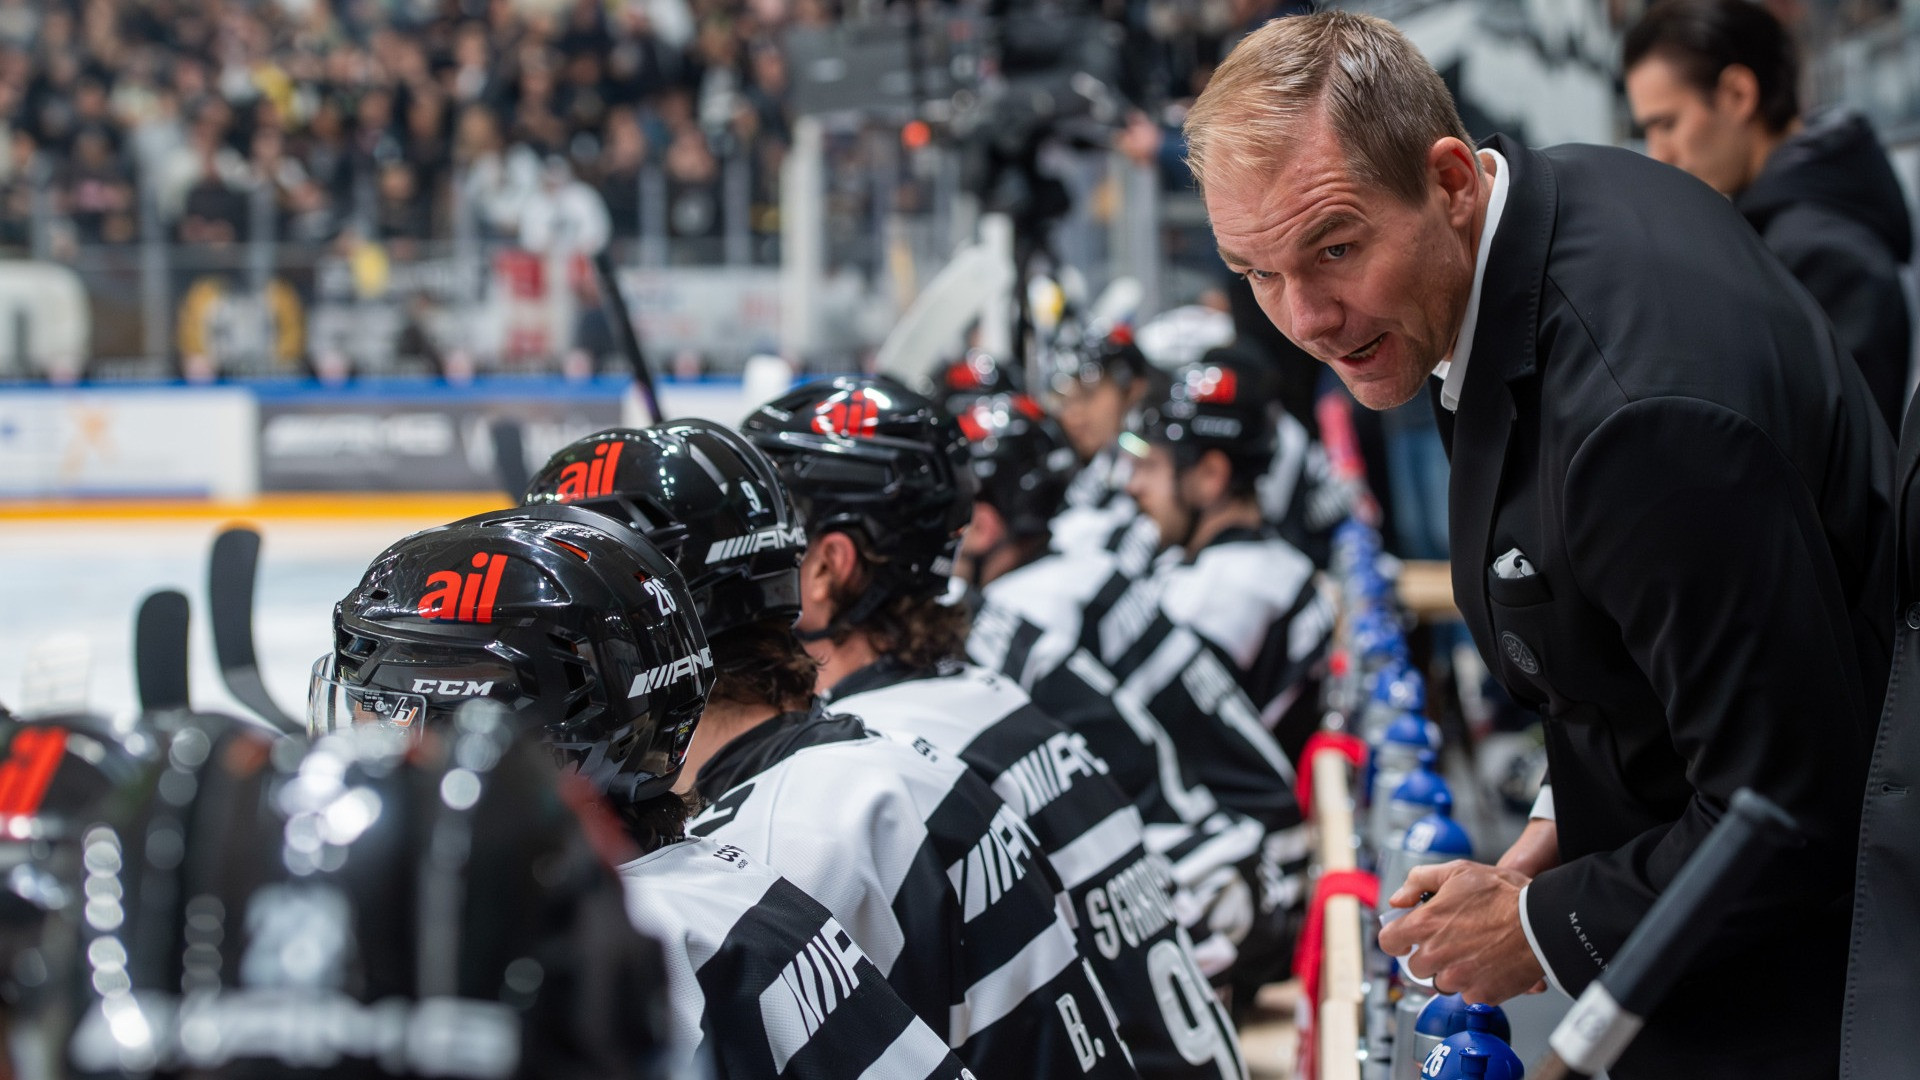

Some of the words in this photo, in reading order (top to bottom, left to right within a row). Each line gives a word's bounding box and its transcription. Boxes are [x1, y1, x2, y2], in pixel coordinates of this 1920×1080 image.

[557, 442, 624, 504] ail
[741, 481, 761, 512] 9
[418, 552, 508, 623] ail
[643, 578, 677, 617] 26
[412, 678, 494, 696] CCM
[1422, 1043, 1451, 1077] 26
